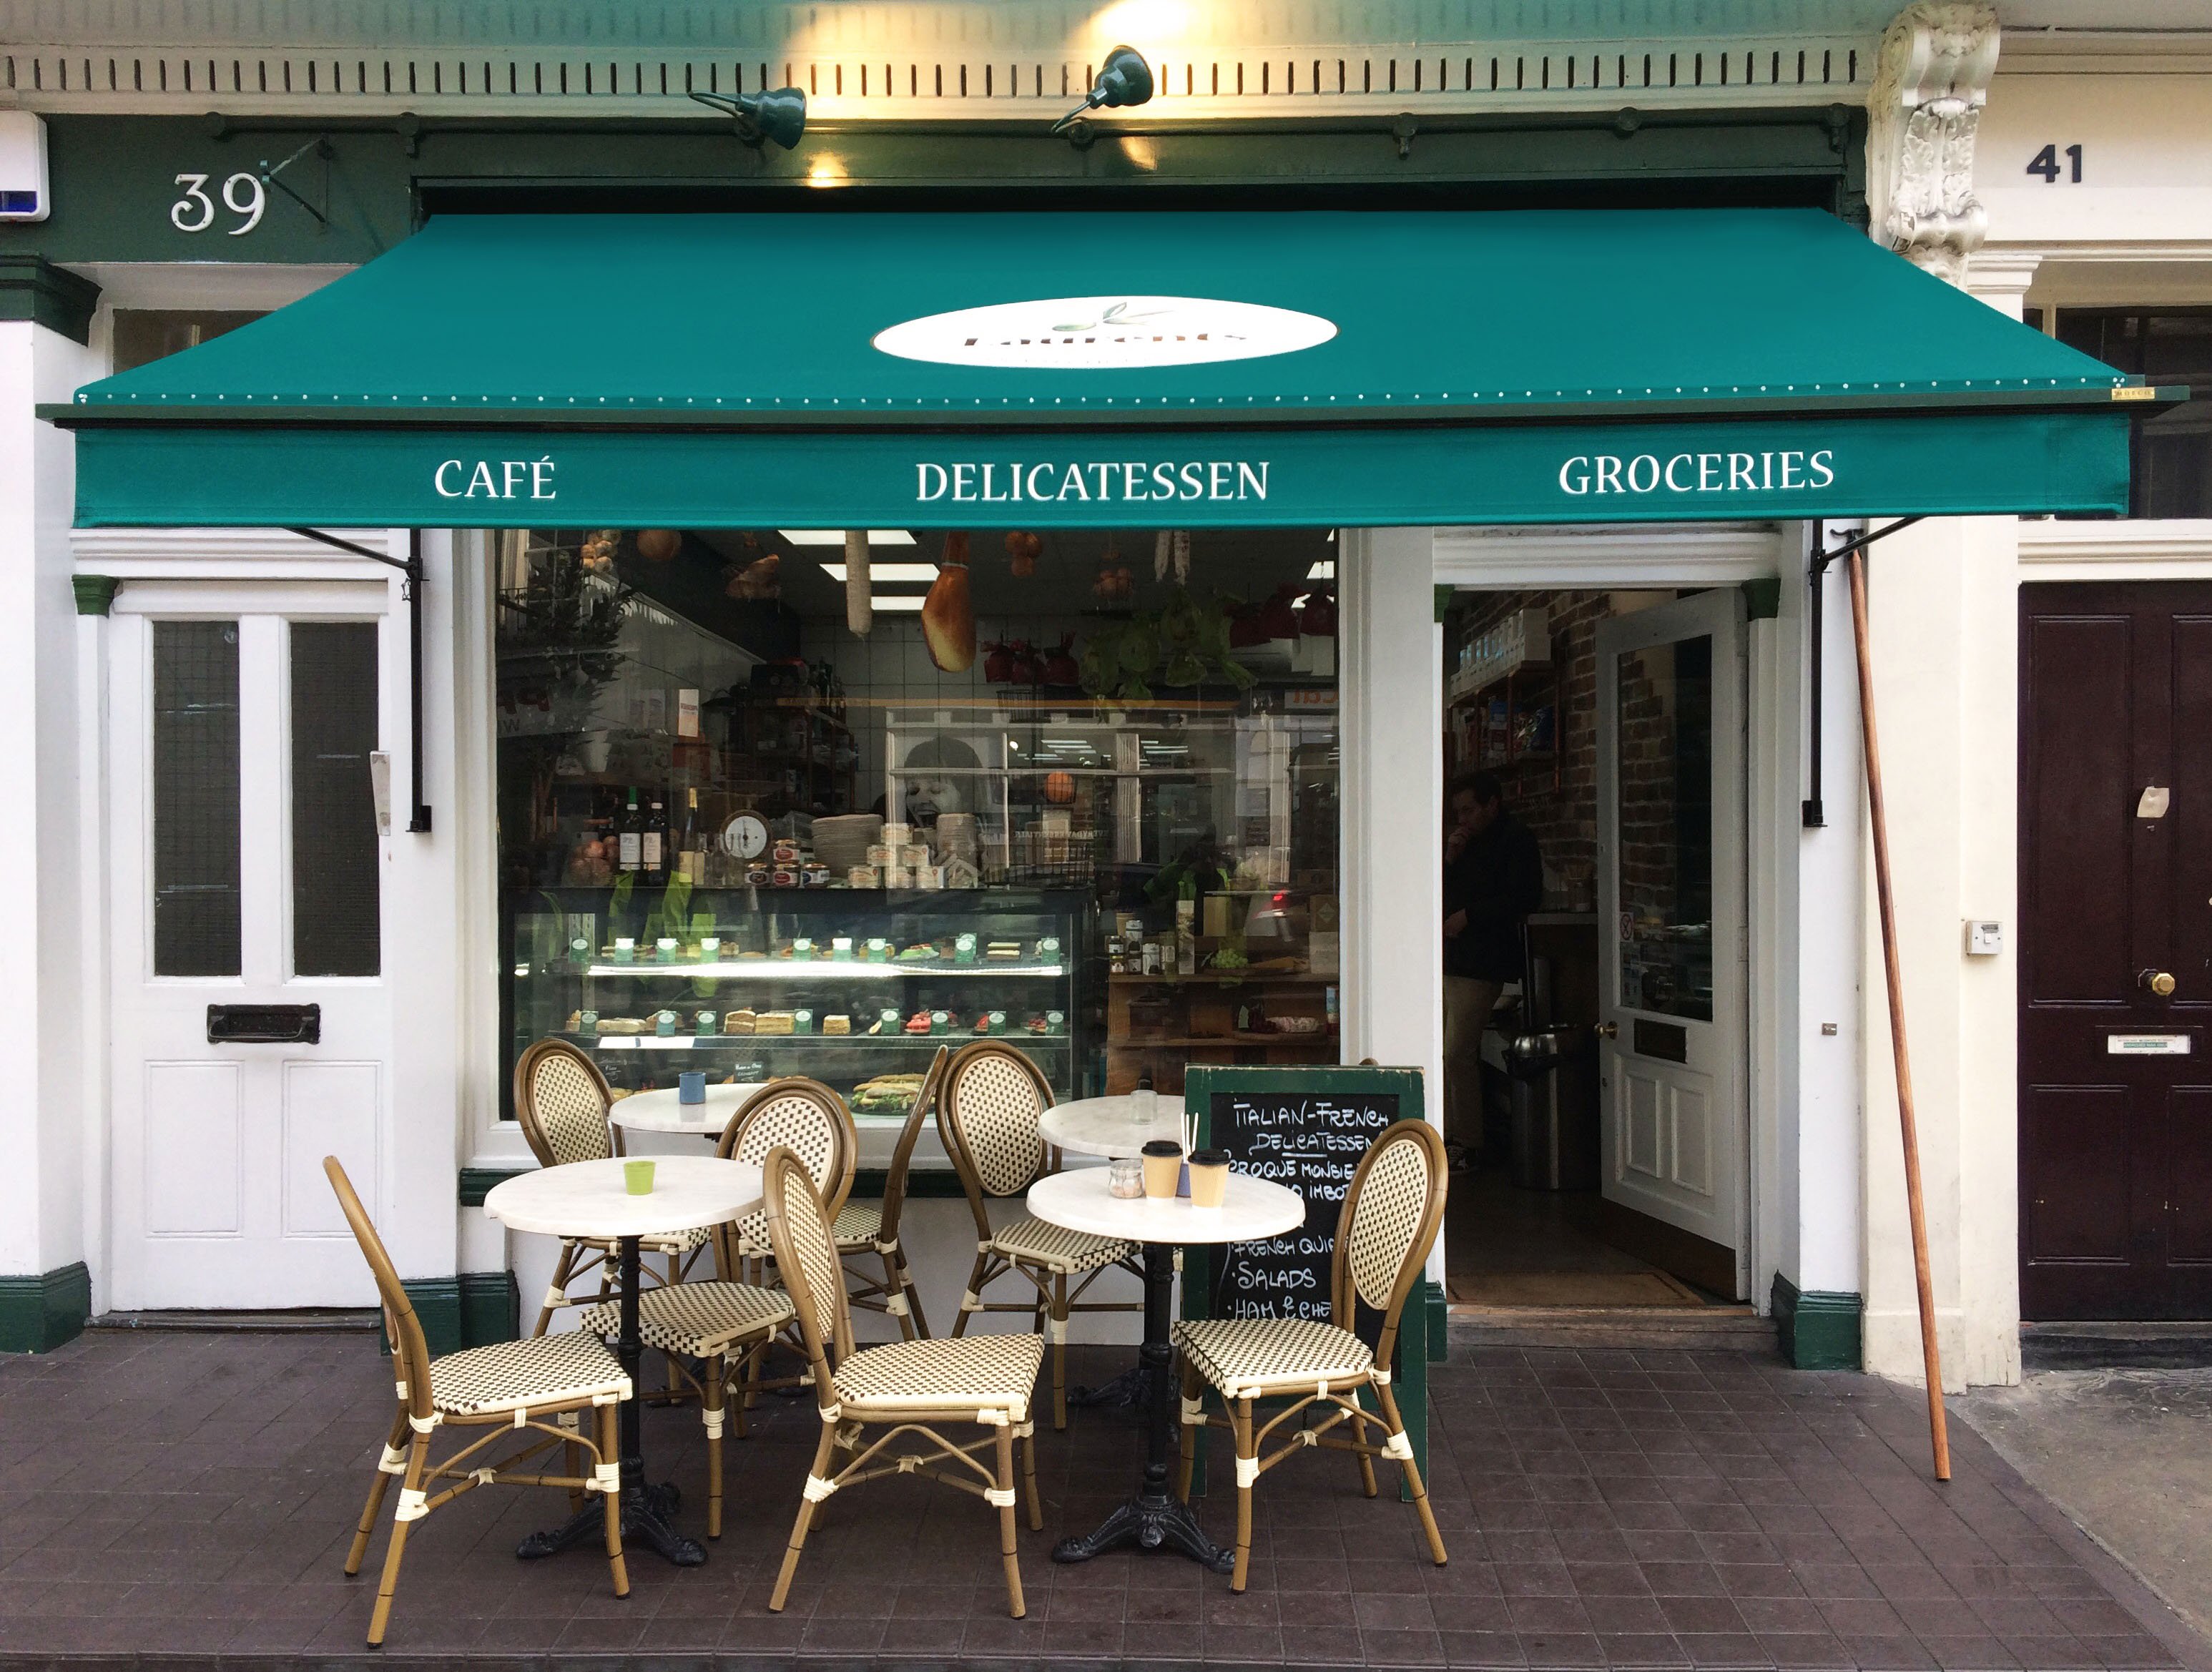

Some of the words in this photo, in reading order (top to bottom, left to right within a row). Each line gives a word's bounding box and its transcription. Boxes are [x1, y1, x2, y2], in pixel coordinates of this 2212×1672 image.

[2026, 144, 2082, 183] 41
[171, 172, 266, 235] 39
[435, 456, 556, 499] CAFÉ
[916, 461, 1270, 502] DELICATESSEN
[1559, 450, 1834, 494] GROCERIES
[1234, 1236, 1295, 1257] FRENCH
[1238, 1261, 1317, 1291] SALADS
[1235, 1298, 1277, 1320] HAM
